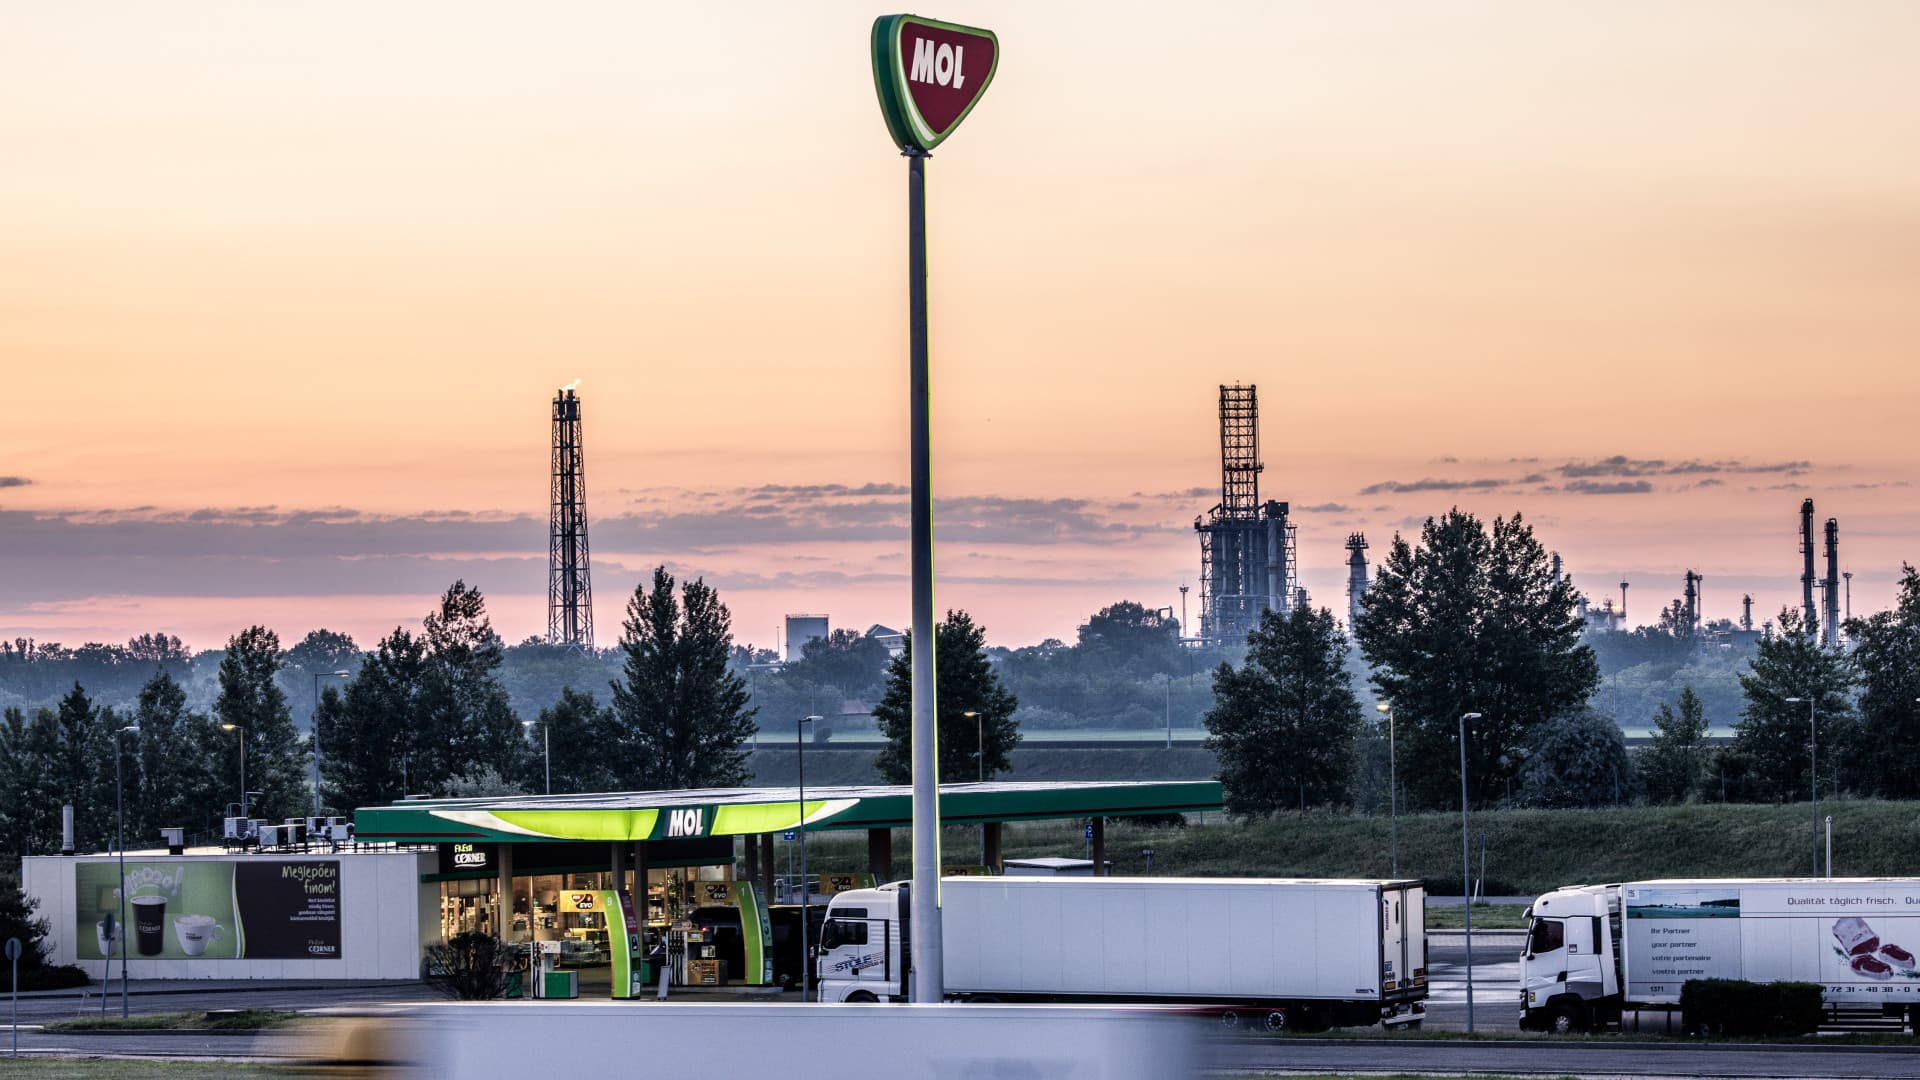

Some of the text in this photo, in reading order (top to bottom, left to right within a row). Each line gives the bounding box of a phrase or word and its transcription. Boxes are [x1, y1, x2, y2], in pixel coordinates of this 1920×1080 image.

[910, 37, 965, 89] MOL
[668, 808, 704, 837] MOL
[454, 853, 486, 864] CORNER
[304, 879, 336, 894] finom!
[1787, 897, 1826, 905] Qualität
[1829, 897, 1863, 907] täglich
[1866, 896, 1897, 905] frisch.
[308, 945, 336, 953] CORNER
